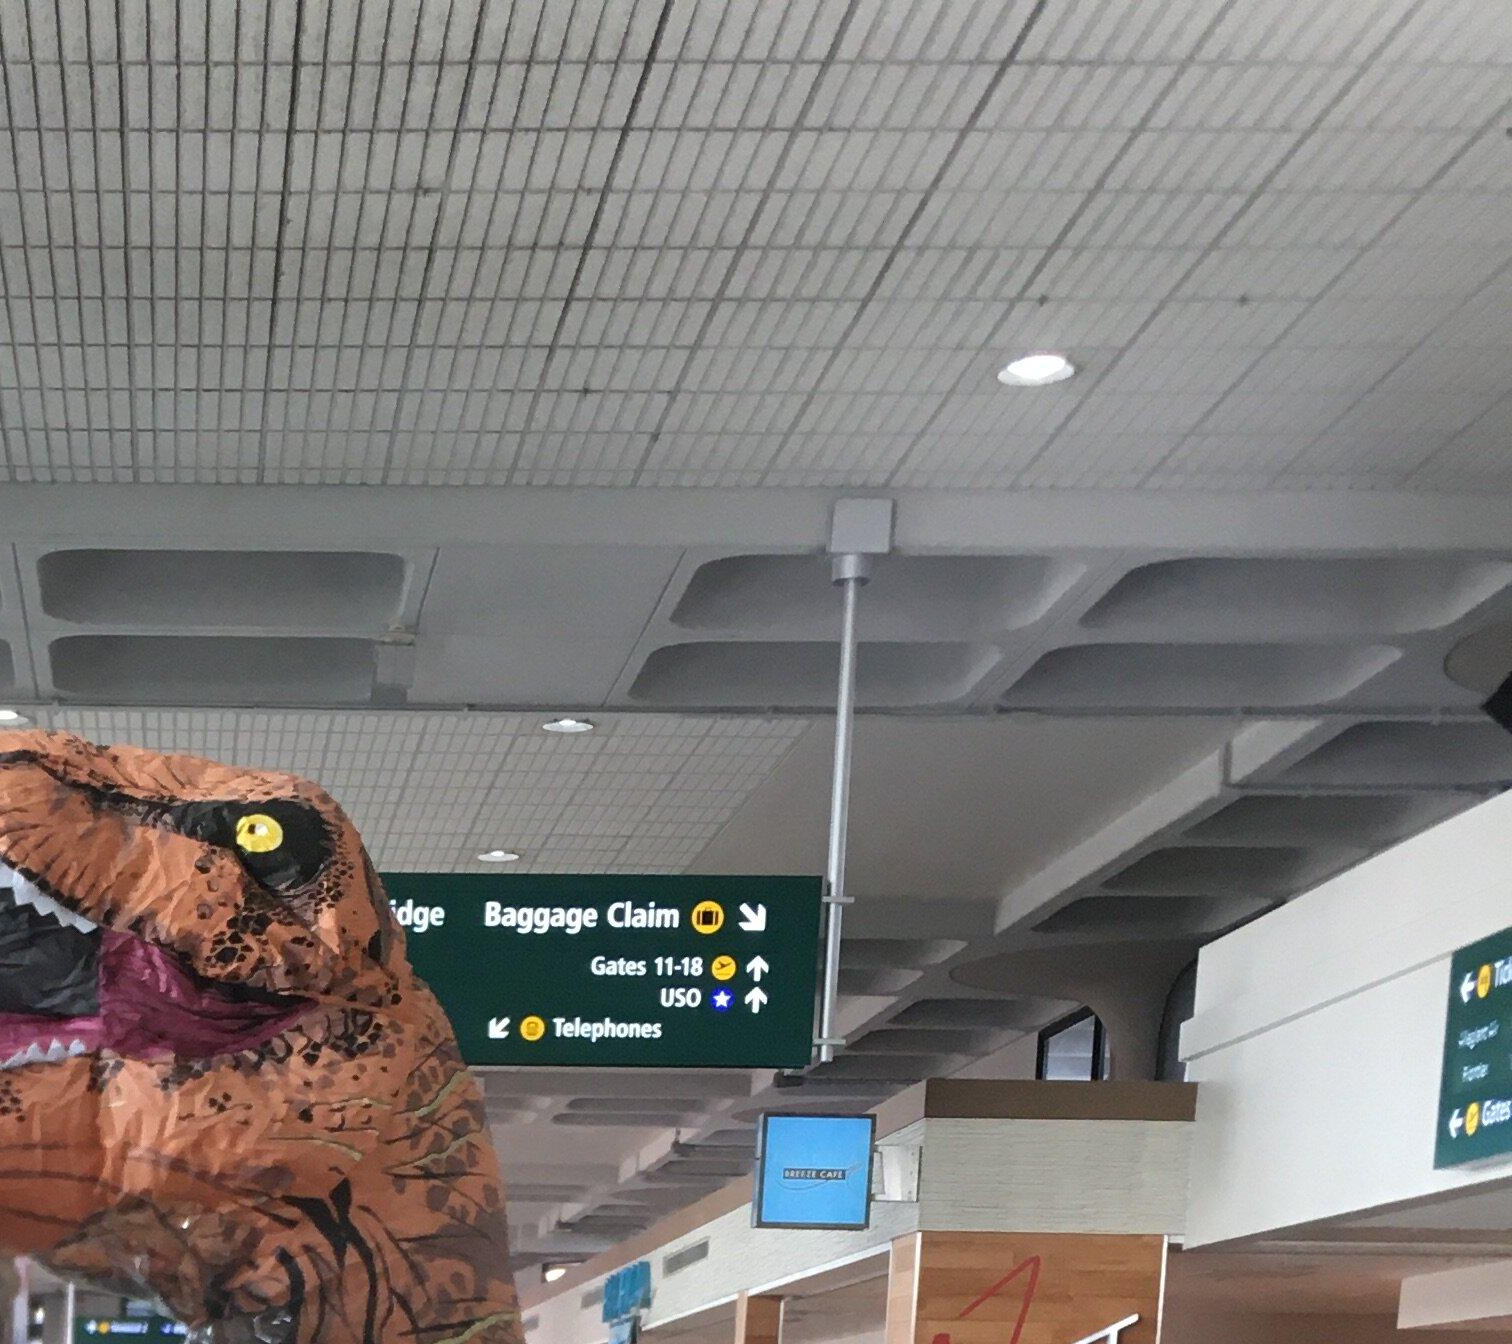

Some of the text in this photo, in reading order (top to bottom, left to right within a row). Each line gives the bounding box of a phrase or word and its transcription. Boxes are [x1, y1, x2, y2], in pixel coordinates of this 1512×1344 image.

[485, 900, 680, 935] Baggage Claim
[590, 955, 704, 977] Gates 11-18
[660, 987, 702, 1008] USO
[553, 1017, 662, 1042] Telephones
[1481, 1099, 1512, 1127] Gates
[784, 1169, 818, 1179] BREEZE
